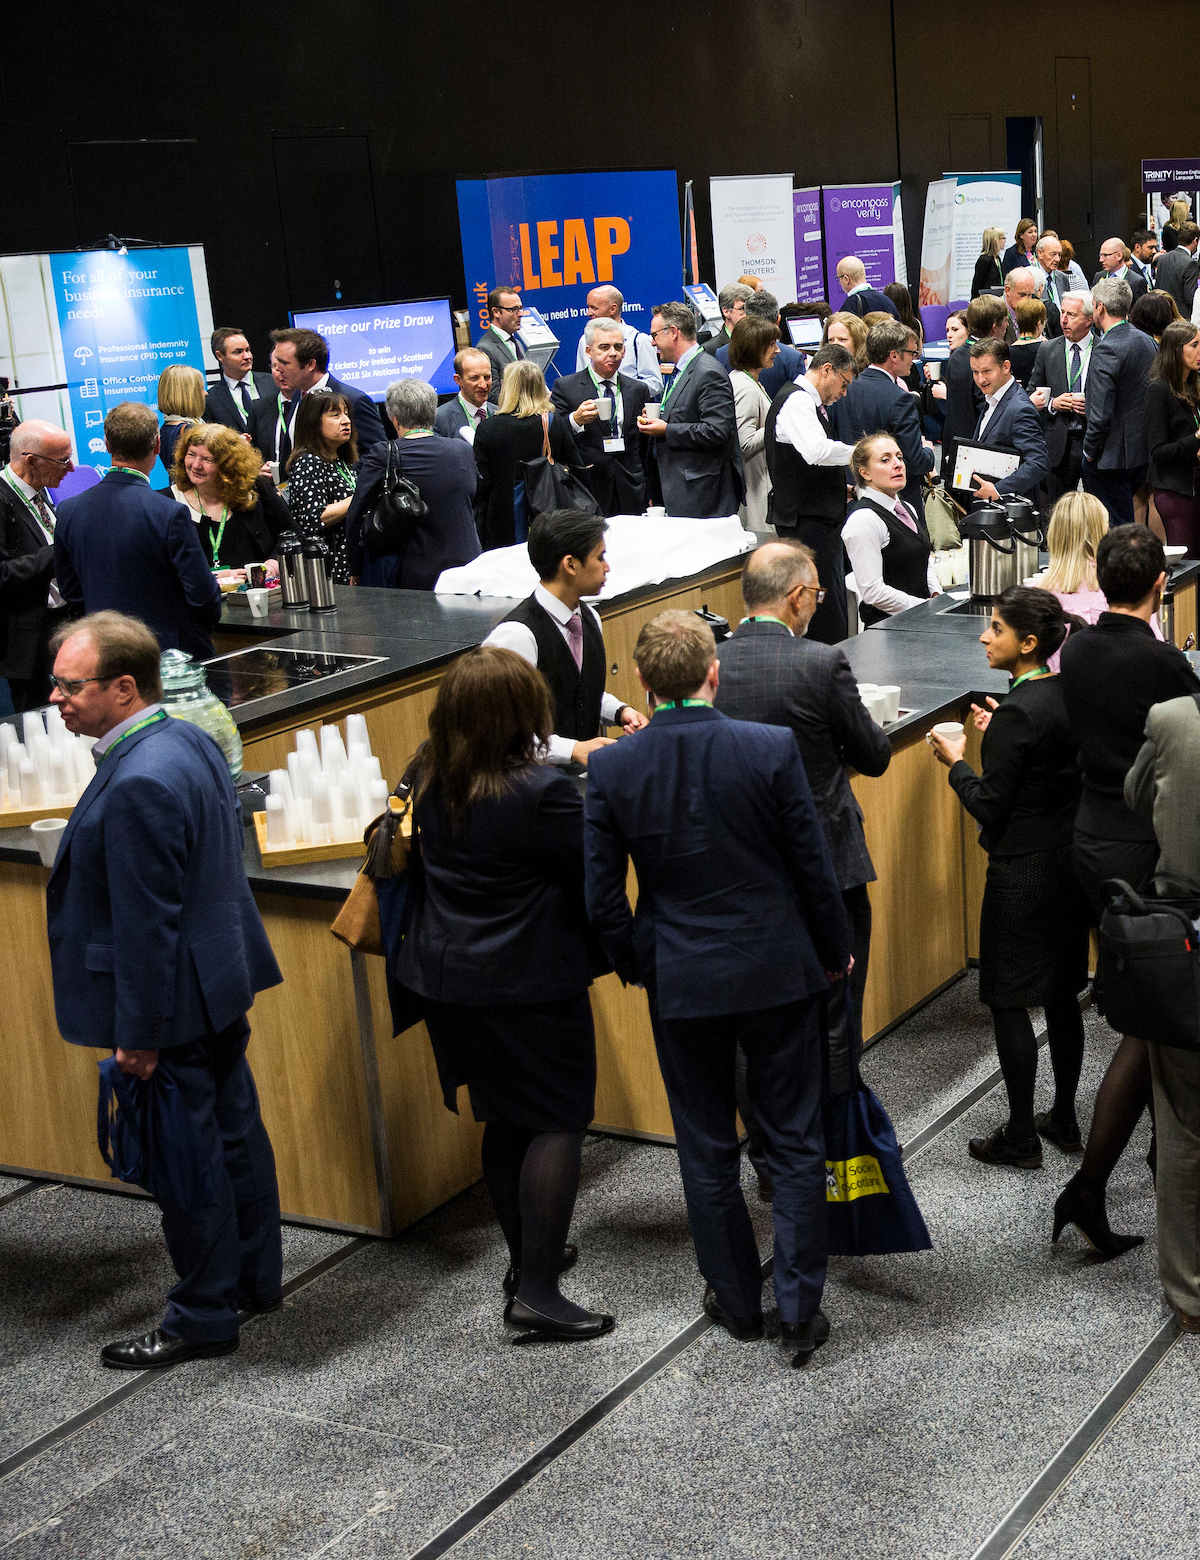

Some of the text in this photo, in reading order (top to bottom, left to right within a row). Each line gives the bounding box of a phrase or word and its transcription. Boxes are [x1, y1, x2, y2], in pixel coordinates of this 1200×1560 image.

[1144, 170, 1172, 179] TRINITY
[796, 202, 819, 214] encompass
[841, 198, 889, 210] encompass
[856, 209, 881, 220] verify
[518, 216, 631, 291] LEAP
[741, 258, 776, 266] THOMSON
[62, 268, 157, 284] For all of your
[744, 267, 775, 275] REUTERS
[64, 286, 184, 302] business insurance
[67, 306, 105, 320] needs
[540, 302, 644, 321] ou need to ru firm.
[317, 315, 434, 336] Enter our Prize Draw
[98, 340, 189, 353] Professional Indemnity
[368, 345, 391, 355] to win
[100, 354, 138, 363] Insurance
[140, 352, 158, 360] (PII)
[335, 360, 358, 370] tickets
[359, 358, 370, 369] for
[372, 356, 396, 366] Ireland
[403, 351, 432, 363] Scotland
[342, 365, 423, 381] 2018 Six Nations Rugby
[102, 374, 160, 385] Office Combin
[104, 385, 147, 395] Insurances
